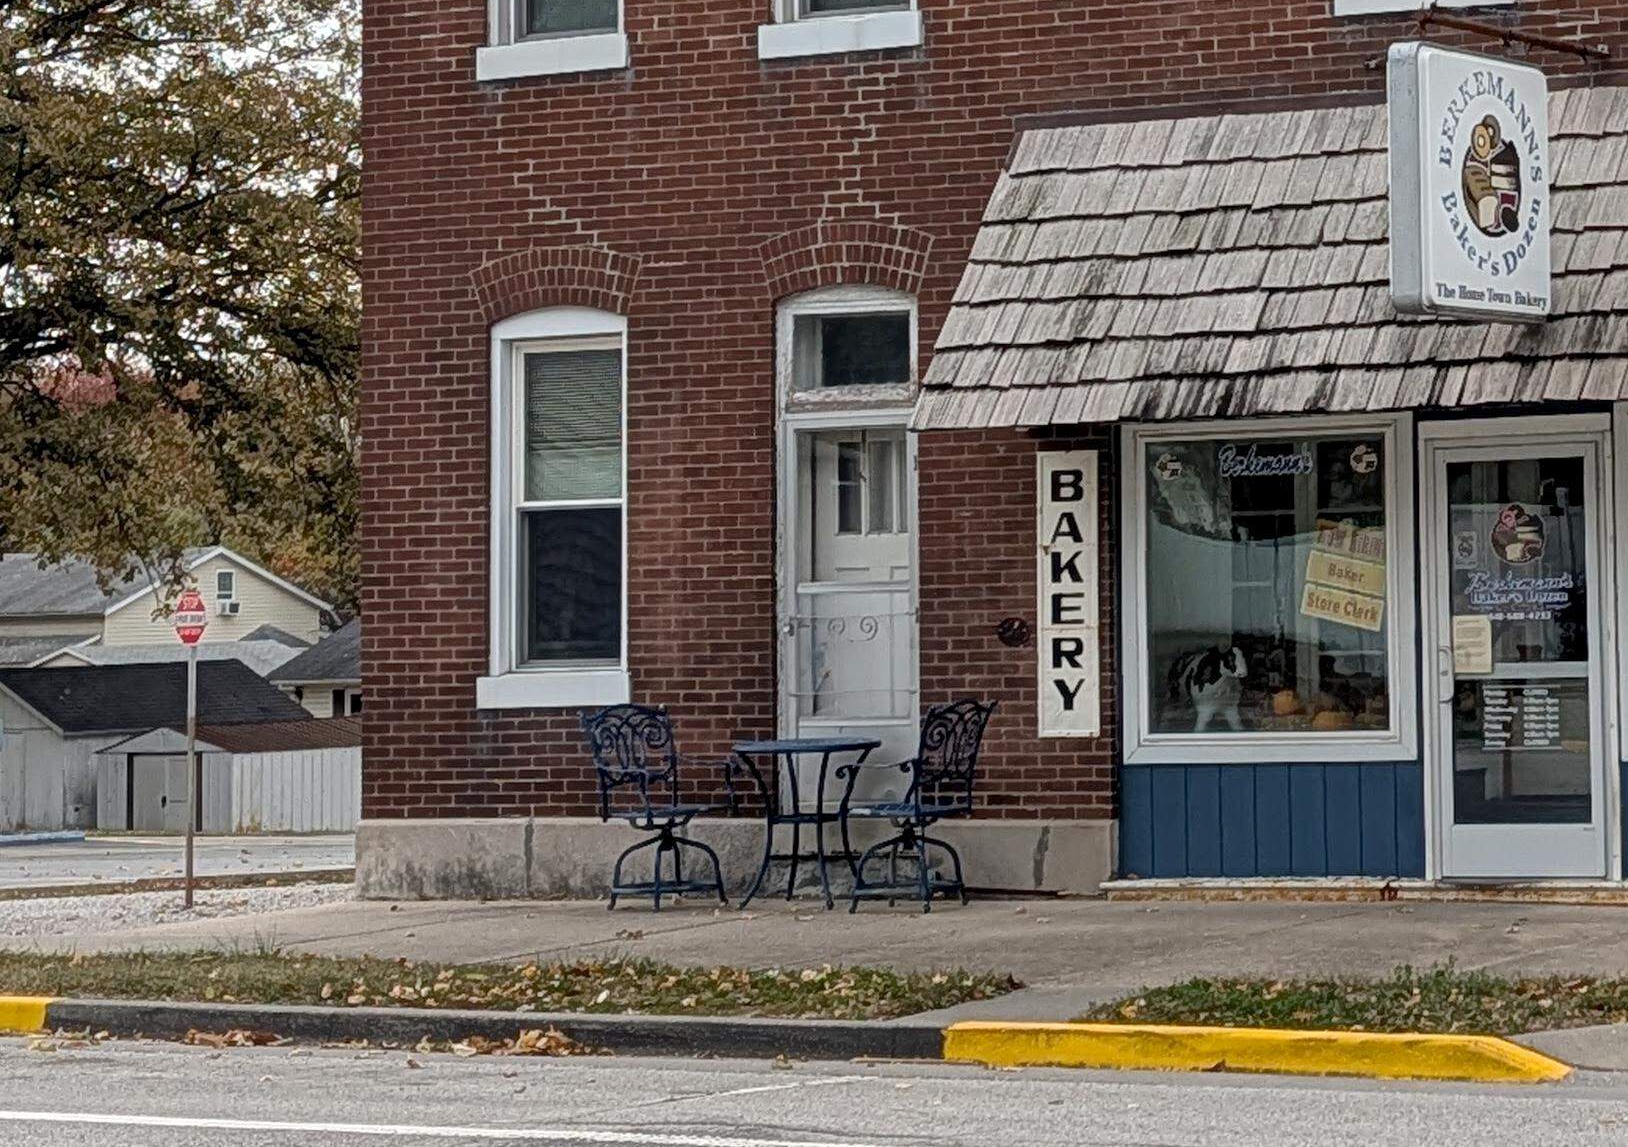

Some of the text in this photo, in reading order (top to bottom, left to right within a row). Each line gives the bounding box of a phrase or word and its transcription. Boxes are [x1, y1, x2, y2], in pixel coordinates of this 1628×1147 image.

[1441, 191, 1541, 277] Baker's Dozen
[1436, 282, 1547, 311] The Home Town Bakery
[1327, 562, 1365, 583] Baker
[1050, 469, 1085, 711] BAKERY
[1307, 592, 1341, 613] Store
